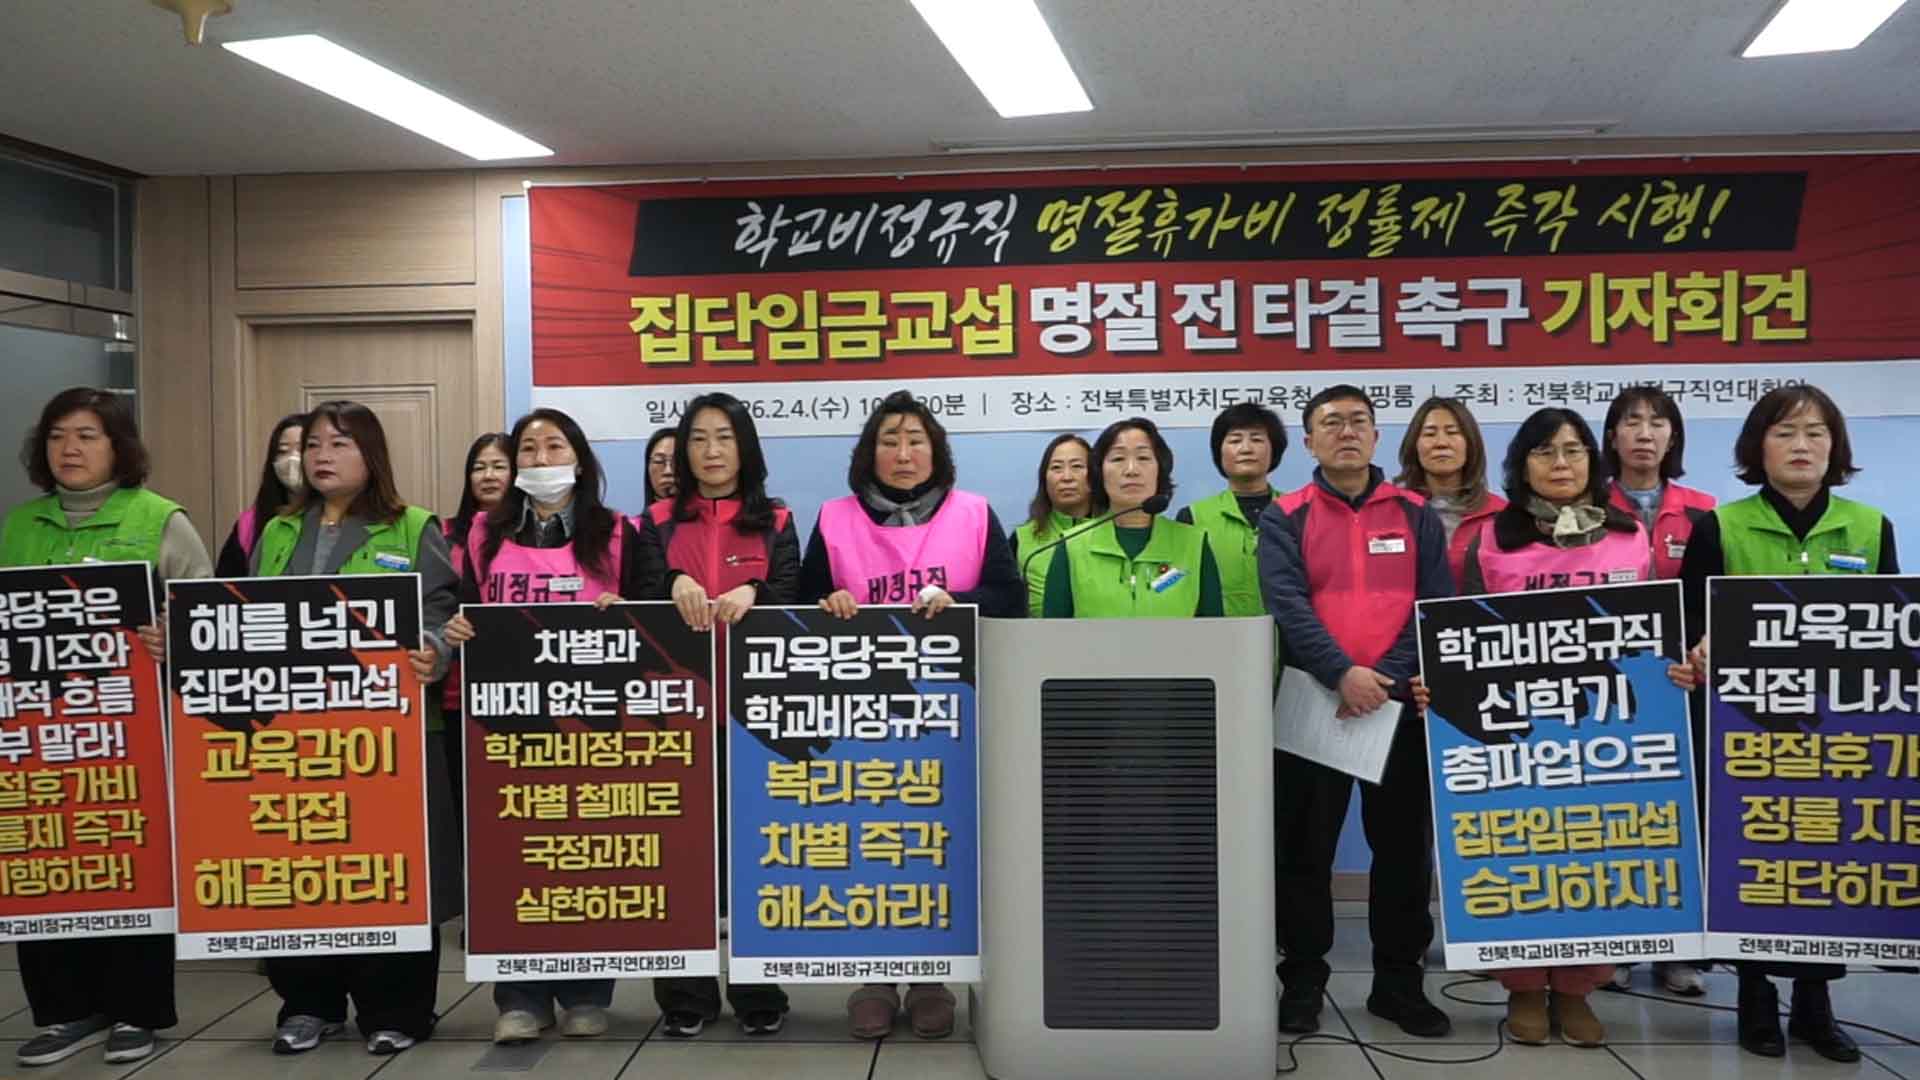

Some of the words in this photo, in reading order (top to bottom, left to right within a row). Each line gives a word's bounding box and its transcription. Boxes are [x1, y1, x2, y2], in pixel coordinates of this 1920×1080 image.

[734, 193, 1018, 269] 학교비정규직
[1036, 187, 1297, 259] 명절휴가비
[1316, 183, 1466, 258] 정률제
[1484, 183, 1579, 253] 즉각
[1597, 180, 1731, 244] 시행!
[629, 283, 1014, 363] 집단임금교섭
[1030, 279, 1159, 354] 명절
[1171, 279, 1238, 351] 전
[1252, 276, 1382, 350] 타결
[1395, 276, 1530, 347] 촉구
[1541, 269, 1808, 344] 기자회견
[1010, 390, 1057, 416] 장소
[1455, 383, 1498, 406] 주최
[189, 602, 289, 651] 해를
[299, 599, 398, 651] 넘긴
[533, 628, 641, 665] 차별과
[1436, 612, 1664, 672] 학교비정규직
[17, 631, 132, 672] 기조와
[742, 634, 963, 681] 교육당국은
[60, 675, 135, 716] 흐름
[179, 663, 410, 716] 집단임금교섭,
[470, 682, 540, 717] 배제
[547, 680, 619, 717] 없는
[624, 678, 706, 720] 일터,
[1477, 673, 1631, 732] 신학기
[1716, 667, 1816, 715] 직접
[745, 692, 960, 740] 학교비정규직
[38, 720, 127, 763] 말라!
[200, 725, 394, 780] 교육감이
[484, 730, 694, 769] 학교비정규직
[1441, 732, 1682, 792] 총파업으로
[497, 783, 569, 820] 차별
[575, 781, 682, 819] 철폐로
[764, 757, 943, 805] 복리후생
[72, 808, 147, 848] 즉각
[248, 791, 348, 843] 직접
[1451, 800, 1680, 858] 집단임금교섭
[1740, 795, 1843, 844] 정률
[520, 832, 661, 871] 국정과제
[759, 821, 849, 868] 차별
[858, 821, 950, 867] 즉각
[193, 852, 407, 907] 해결하라!
[1460, 857, 1681, 917] 승리하자!
[514, 884, 668, 923] 실현하라!
[757, 882, 950, 929] 해소하라!
[206, 930, 398, 954] 전북학교비정규직연대회의
[496, 954, 687, 975] 전북학교비정규직연대회의
[1477, 937, 1676, 963] 전북학교비정규직연대회의
[762, 960, 952, 978] 전북학교비정규직연대회의
